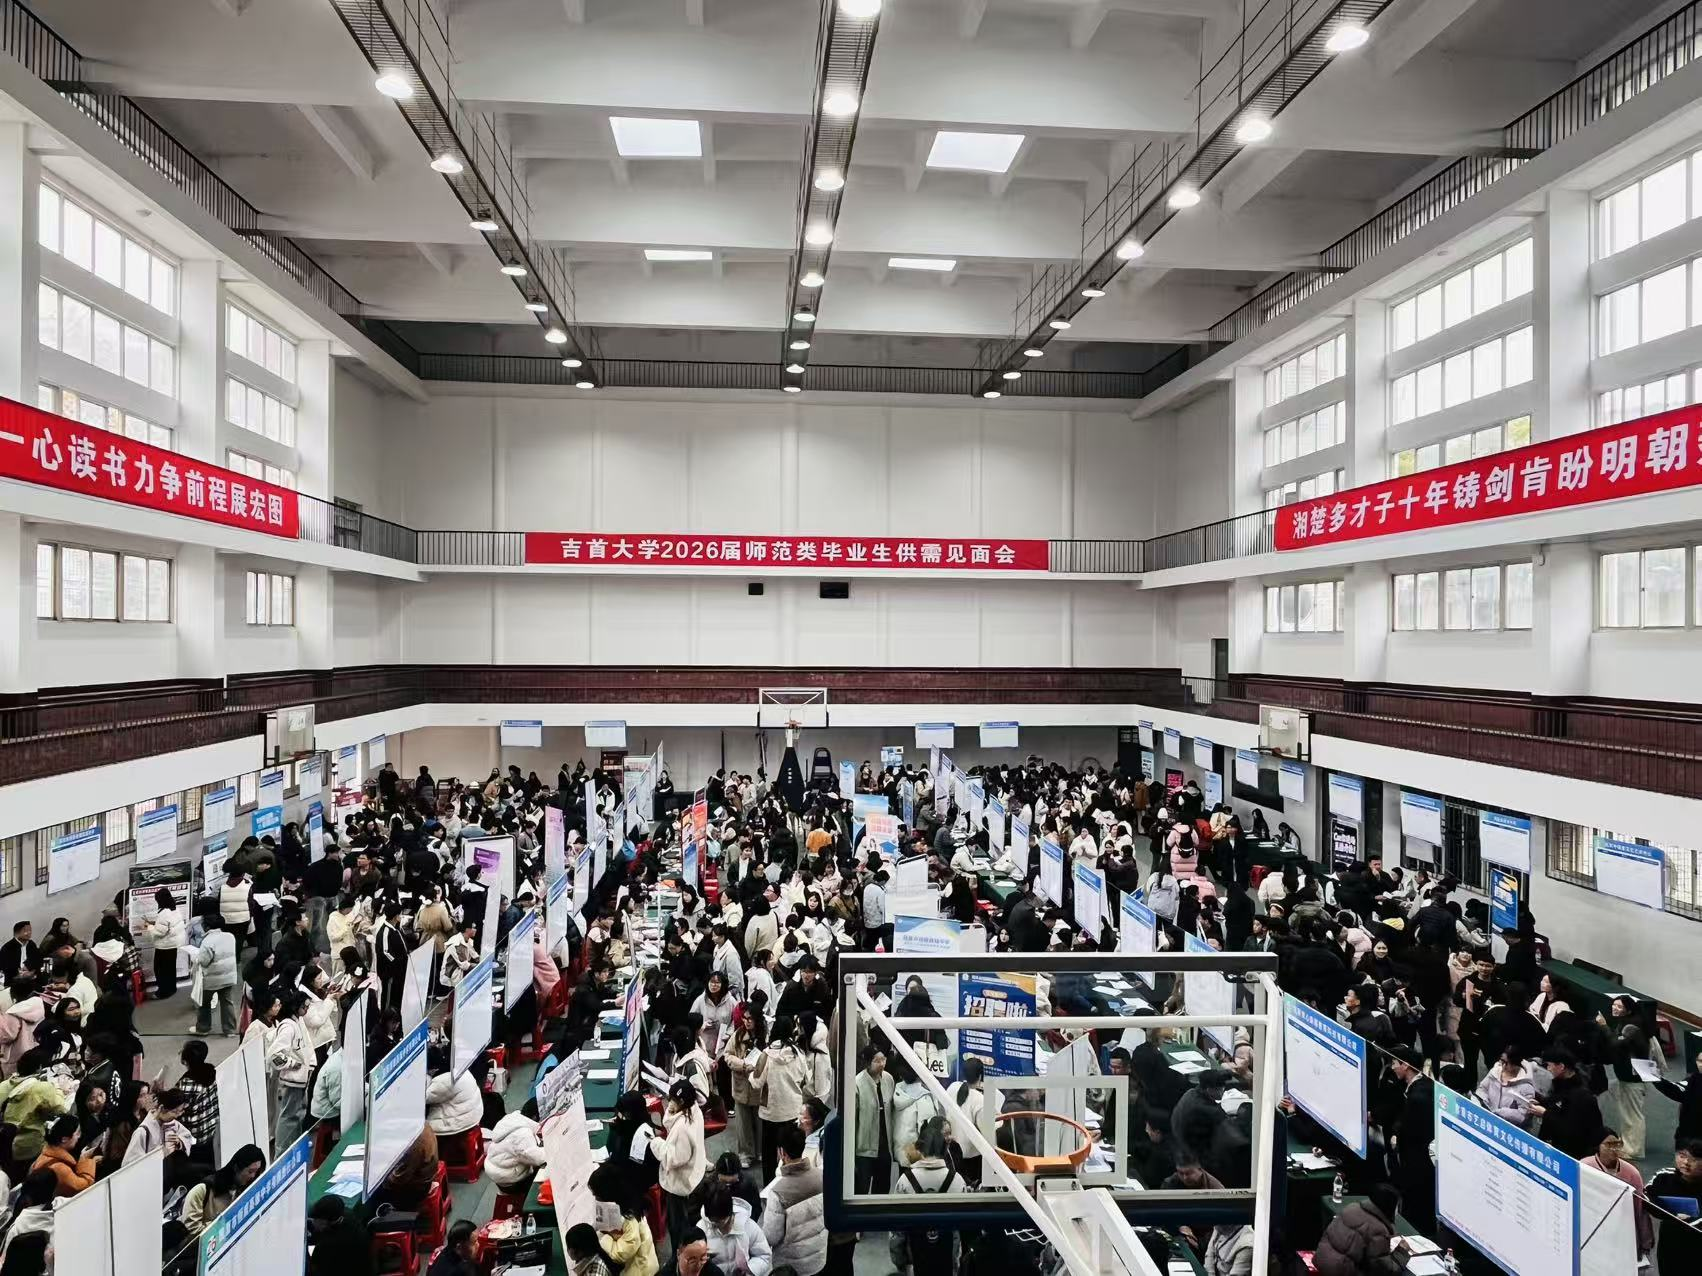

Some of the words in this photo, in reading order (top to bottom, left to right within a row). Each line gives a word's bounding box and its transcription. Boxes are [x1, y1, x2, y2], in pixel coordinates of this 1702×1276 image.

[0, 427, 283, 527] 一心读书力争前程展宏图
[1292, 421, 1702, 540] 湘楚多才子十年铸剑肯盼明朝
[561, 538, 1017, 564] 吉首大学2026届师范类毕业生供需见面会
